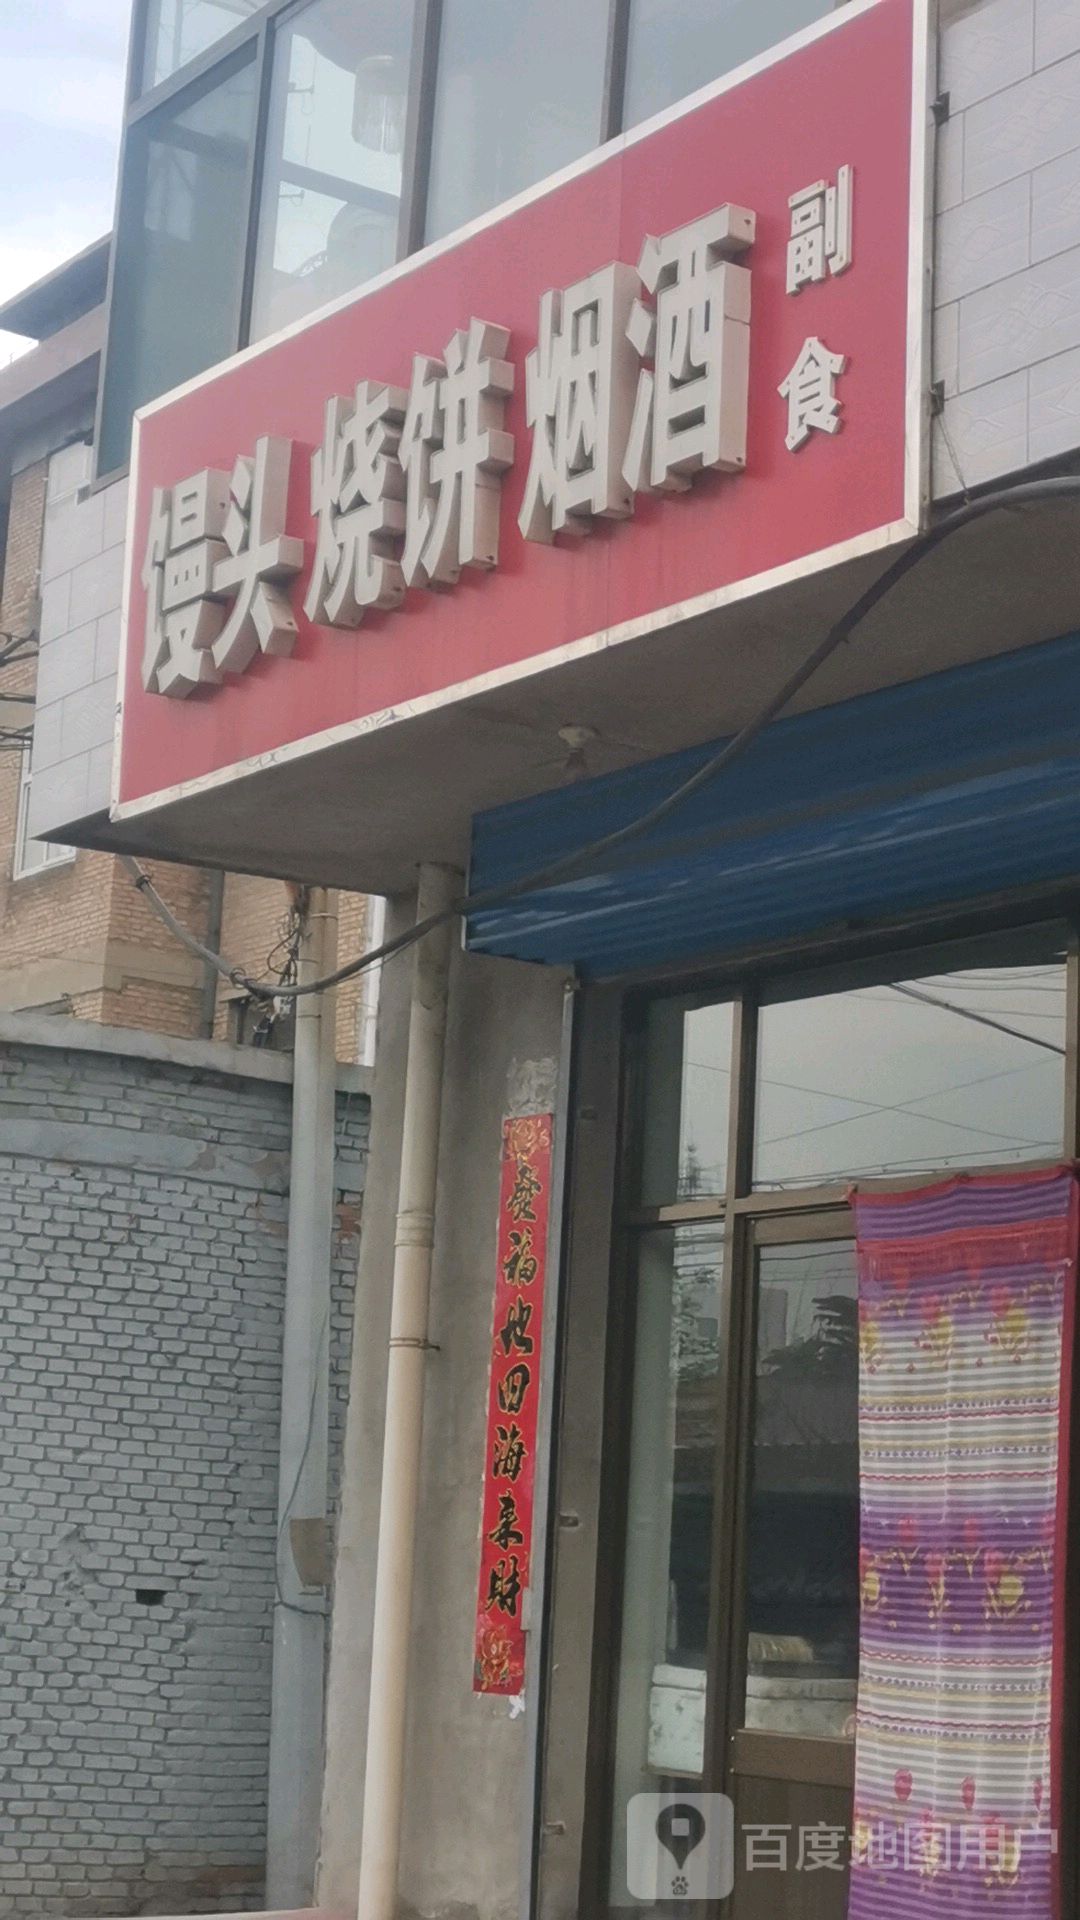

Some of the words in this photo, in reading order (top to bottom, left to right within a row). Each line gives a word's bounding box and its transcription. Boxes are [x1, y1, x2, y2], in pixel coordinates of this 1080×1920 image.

[141, 202, 757, 700] 馒头烧饼烟酒
[778, 163, 855, 452] 副食
